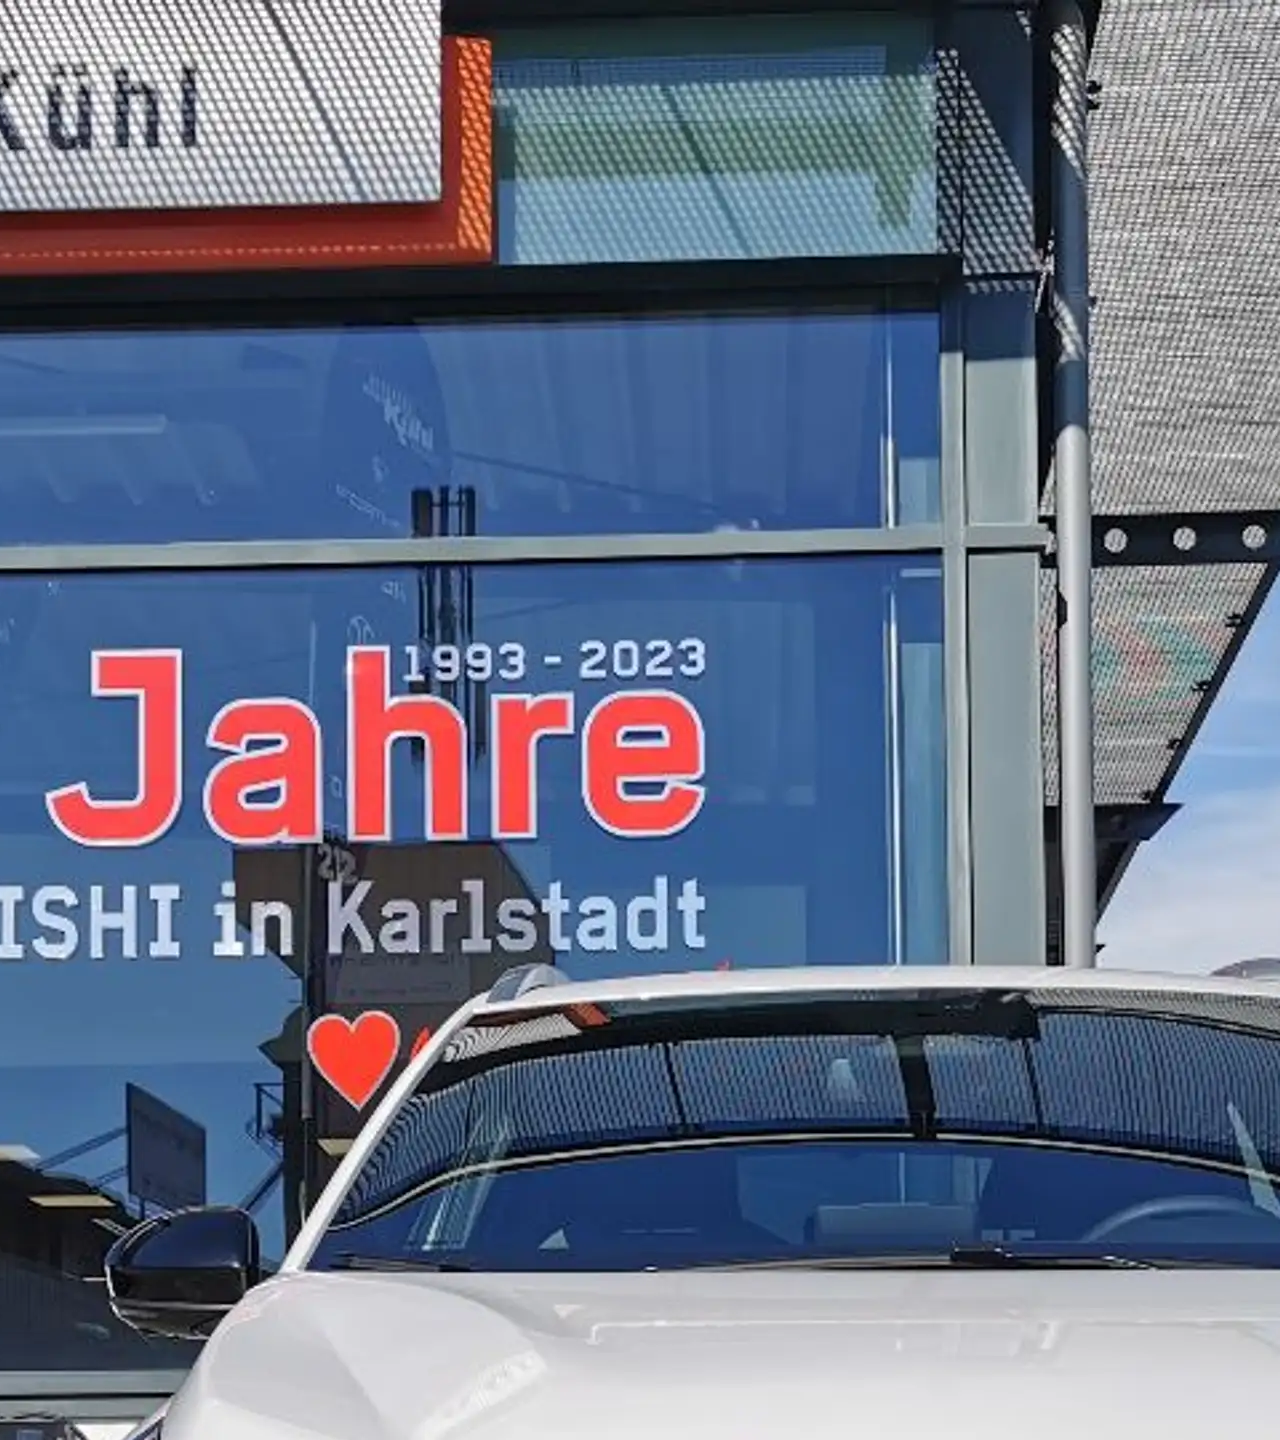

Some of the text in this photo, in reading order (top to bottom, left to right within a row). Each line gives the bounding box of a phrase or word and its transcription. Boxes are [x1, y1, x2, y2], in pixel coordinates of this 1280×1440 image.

[402, 642, 528, 684] 1993
[578, 637, 708, 680] 2023
[44, 644, 708, 849] Jahre
[212, 880, 296, 958] in
[326, 875, 708, 956] Karlstadt
